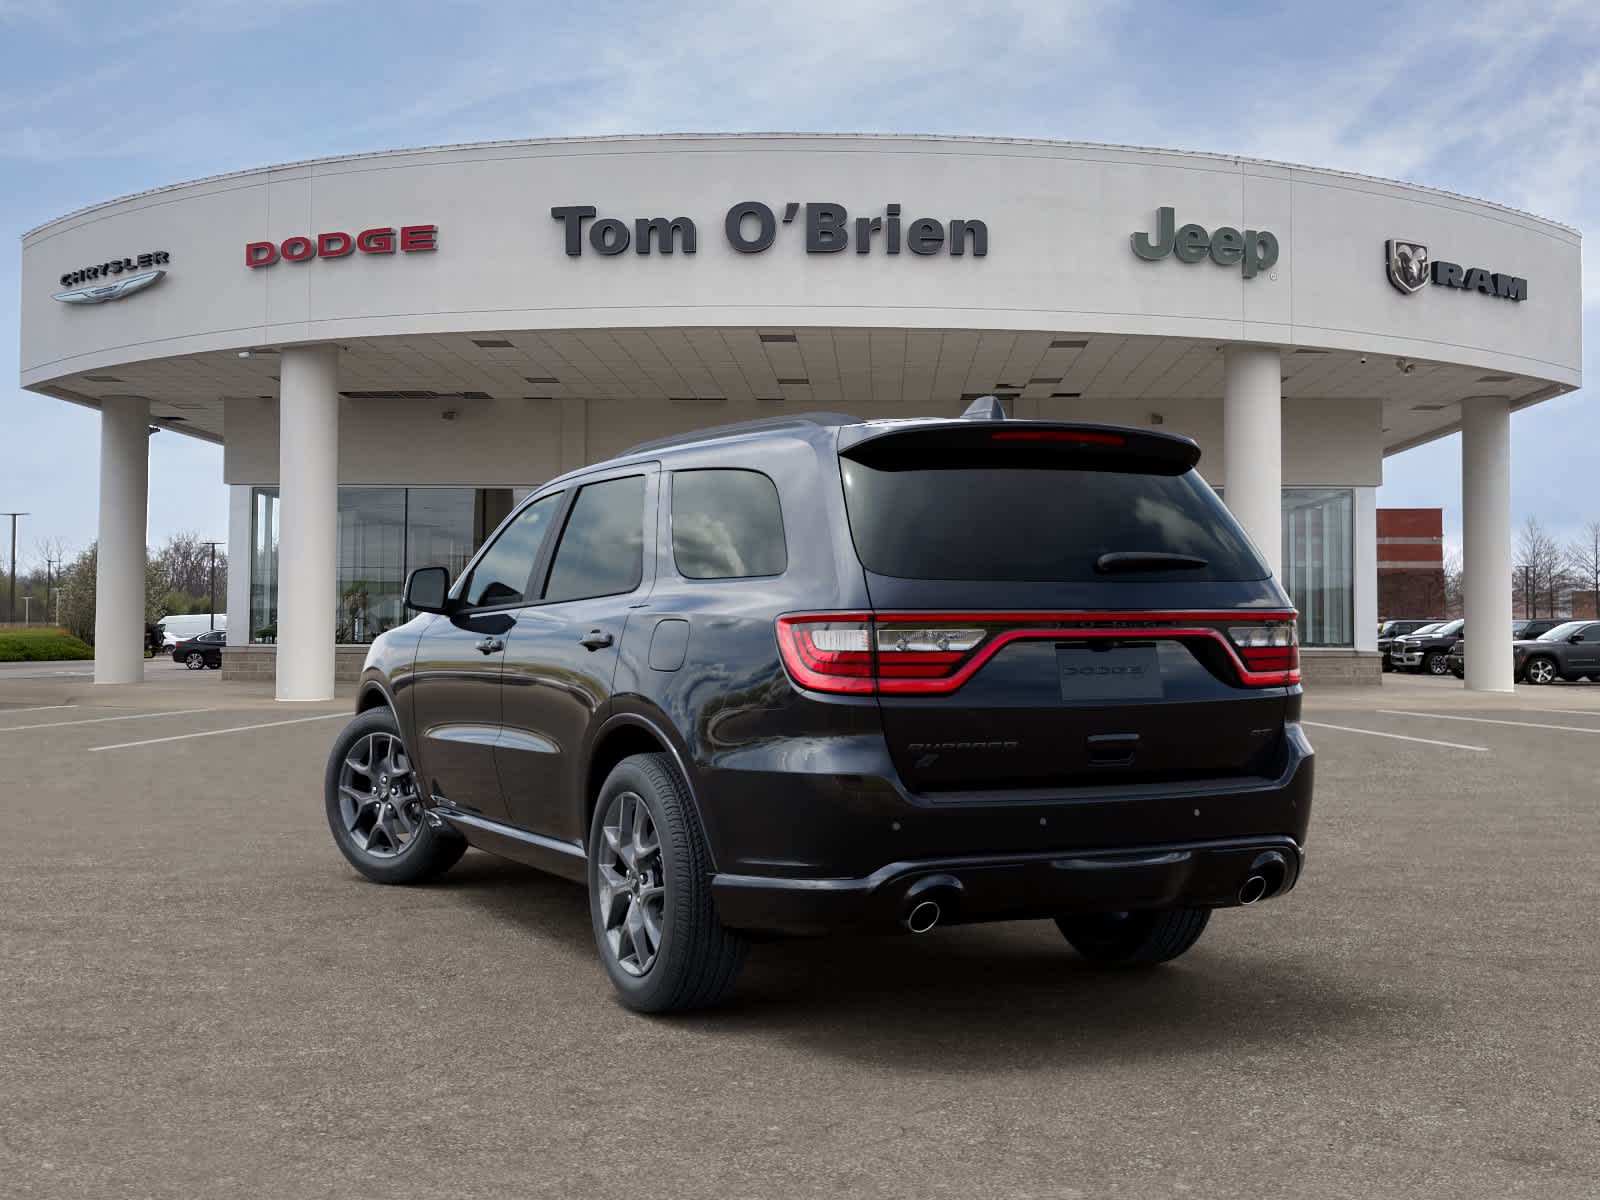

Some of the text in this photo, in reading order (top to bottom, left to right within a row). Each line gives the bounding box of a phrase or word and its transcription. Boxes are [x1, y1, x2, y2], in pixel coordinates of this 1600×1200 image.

[245, 224, 437, 269] DODGE
[551, 201, 989, 257] Tom O'Brien
[1130, 207, 1279, 279] Jeep
[60, 251, 170, 286] CHRYSLER
[1431, 261, 1528, 301] RAM
